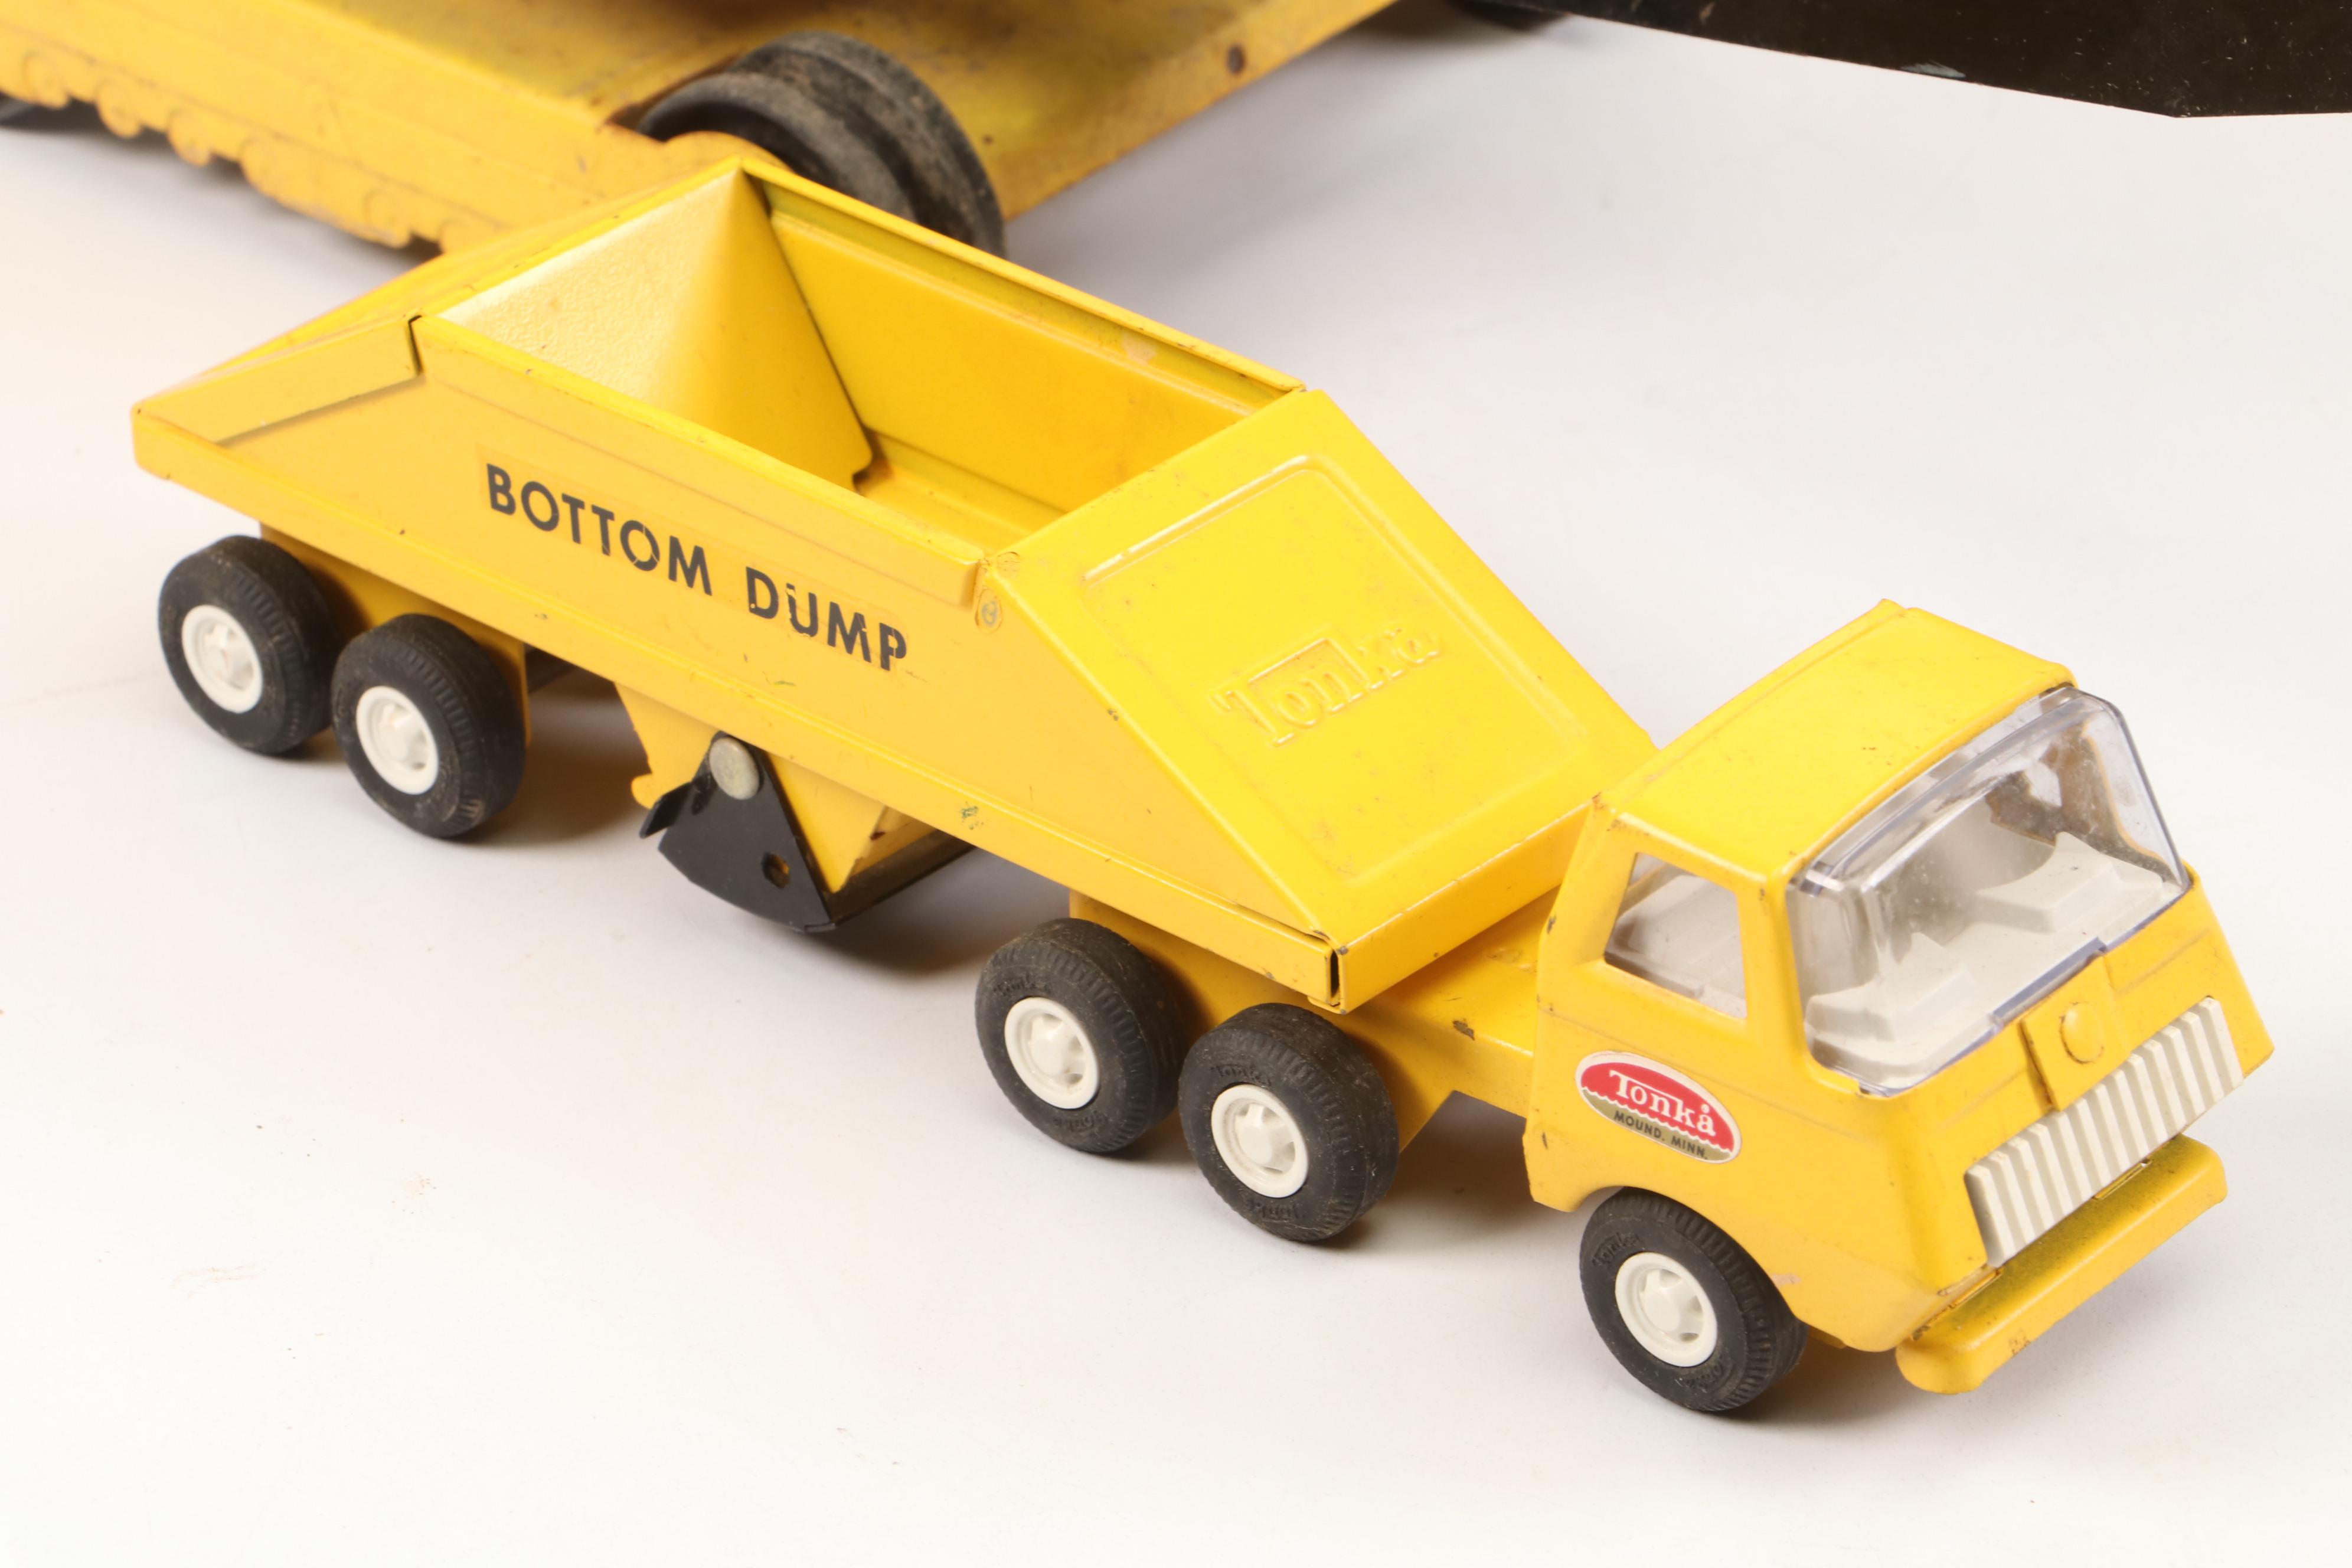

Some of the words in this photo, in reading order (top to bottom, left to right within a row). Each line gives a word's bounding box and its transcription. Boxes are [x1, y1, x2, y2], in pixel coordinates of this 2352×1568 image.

[486, 463, 712, 596] BOTTOM
[746, 566, 908, 671] DUMP
[1208, 622, 1443, 746] Tonka
[1609, 1069, 1716, 1136] Tonka
[1671, 1135, 1709, 1160] MINN.
